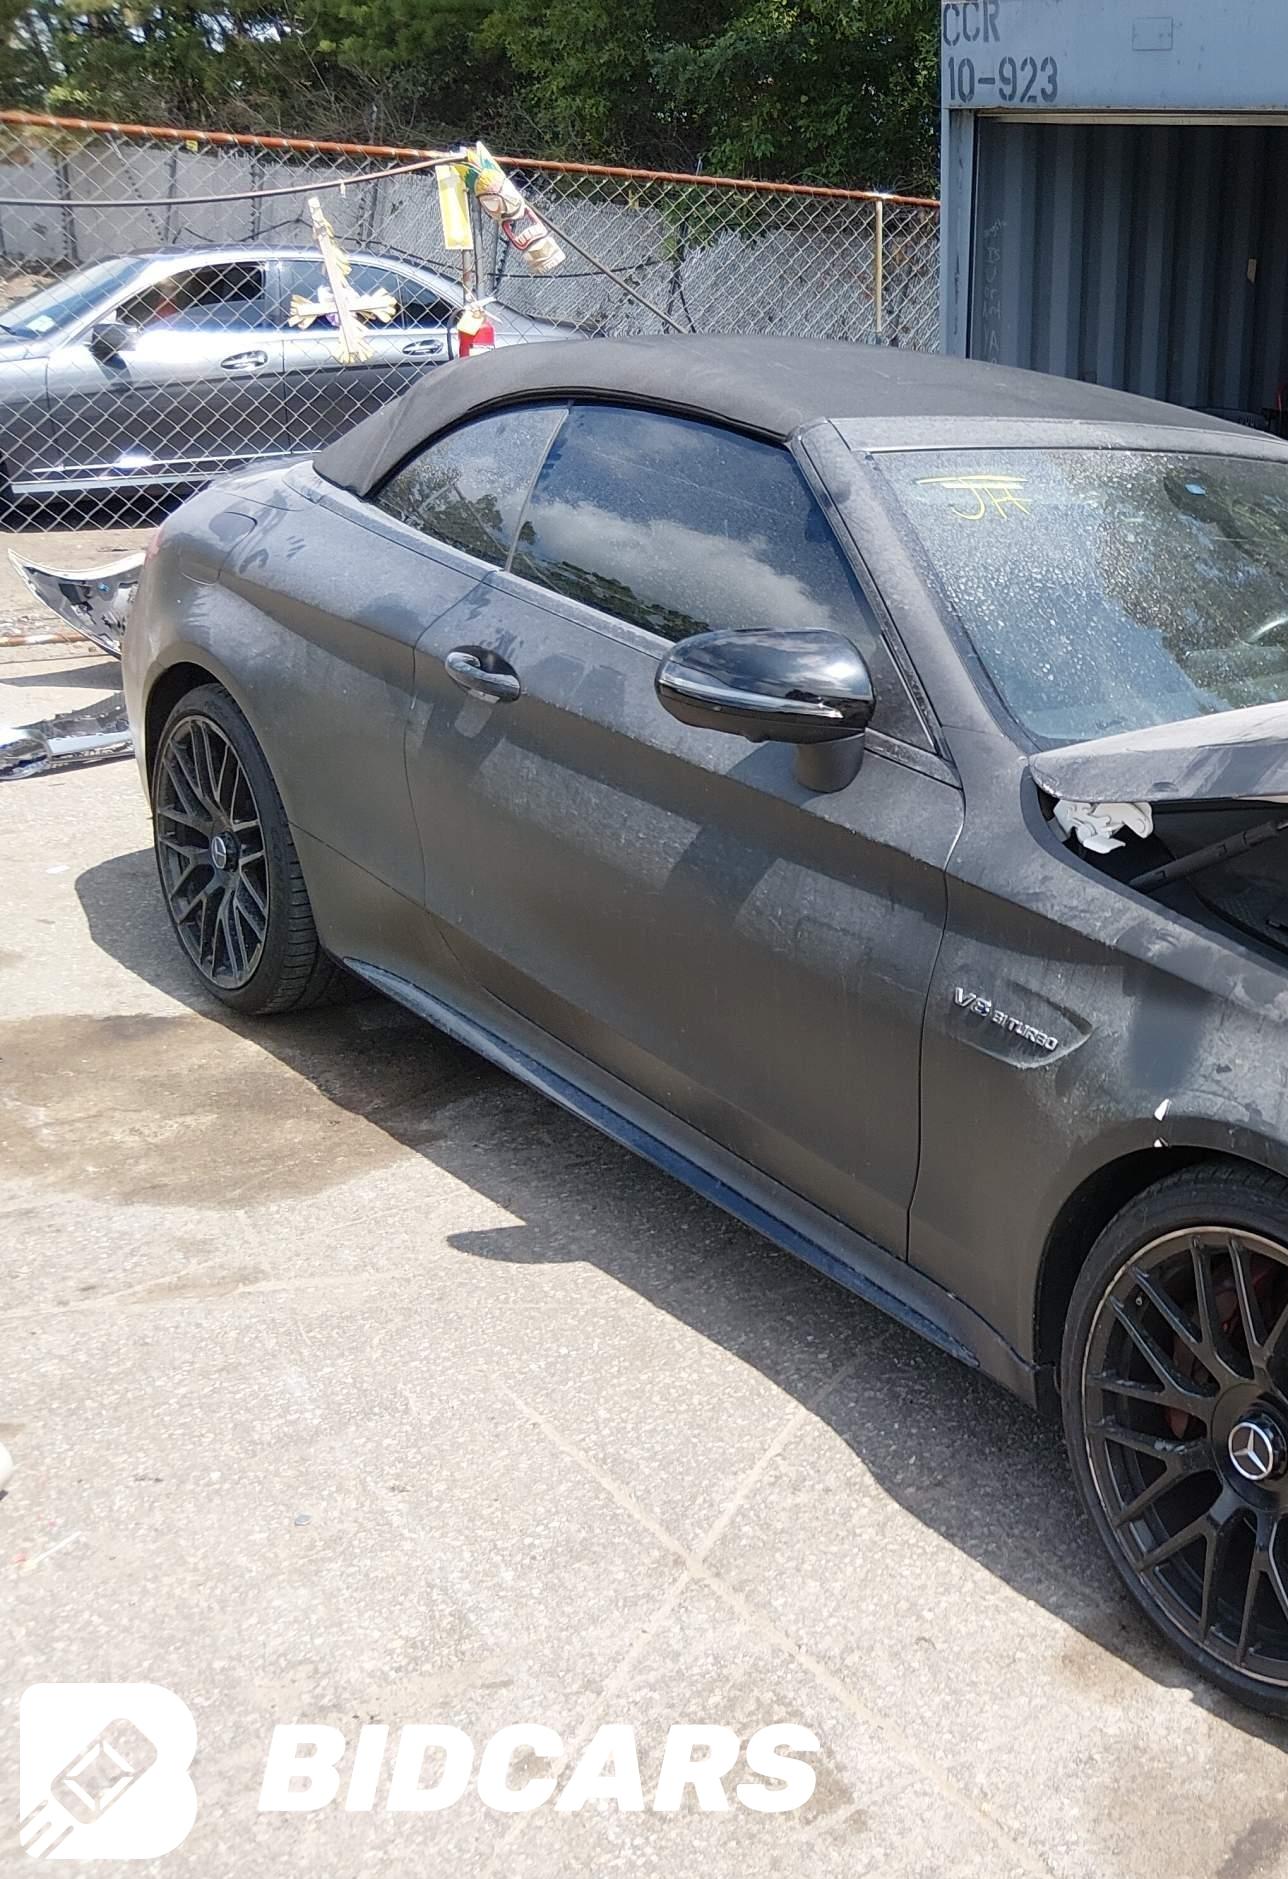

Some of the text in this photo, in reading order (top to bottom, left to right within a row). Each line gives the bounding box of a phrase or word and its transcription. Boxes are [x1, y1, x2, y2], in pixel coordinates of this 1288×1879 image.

[943, 0, 1000, 47] CCR
[948, 56, 1058, 103] 10-923
[953, 986, 993, 1017] V8
